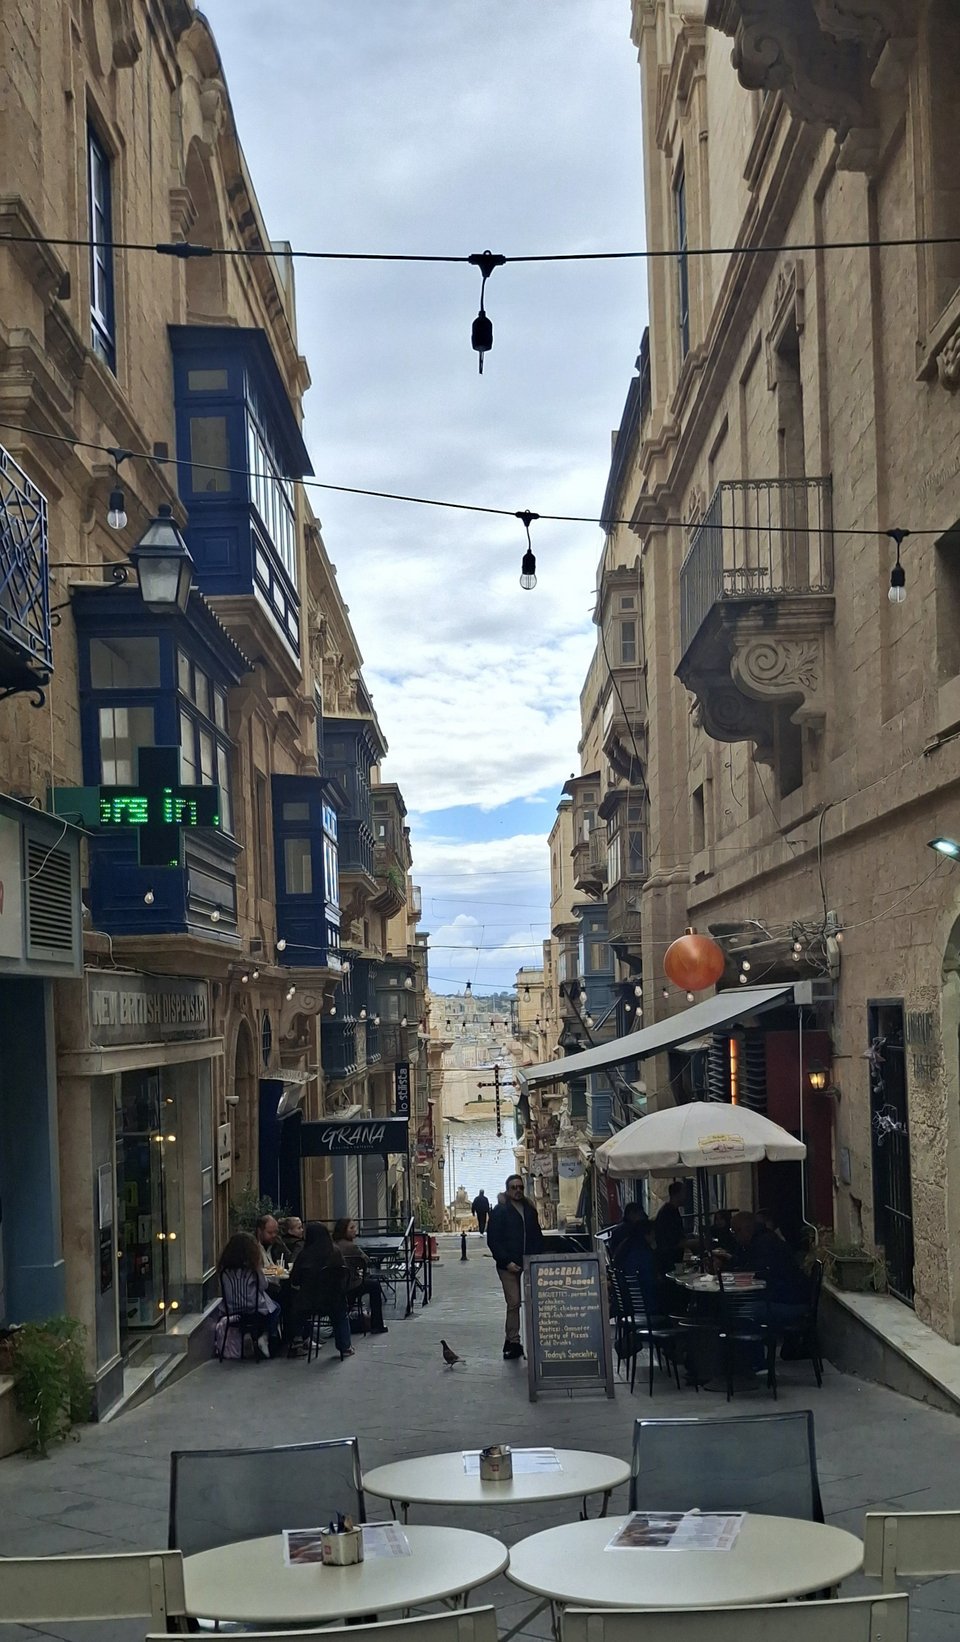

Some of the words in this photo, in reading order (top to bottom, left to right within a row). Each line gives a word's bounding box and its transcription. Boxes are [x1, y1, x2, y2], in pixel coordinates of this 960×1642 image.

[92, 990, 118, 1025] NEW
[120, 991, 161, 1025] BRITISH
[162, 993, 208, 1024] DISPENSARY
[321, 1124, 386, 1151] GRANA
[538, 1267, 582, 1276] DOLCERIA
[539, 1332, 561, 1340] Variety
[567, 1348, 598, 1359] Speciality
